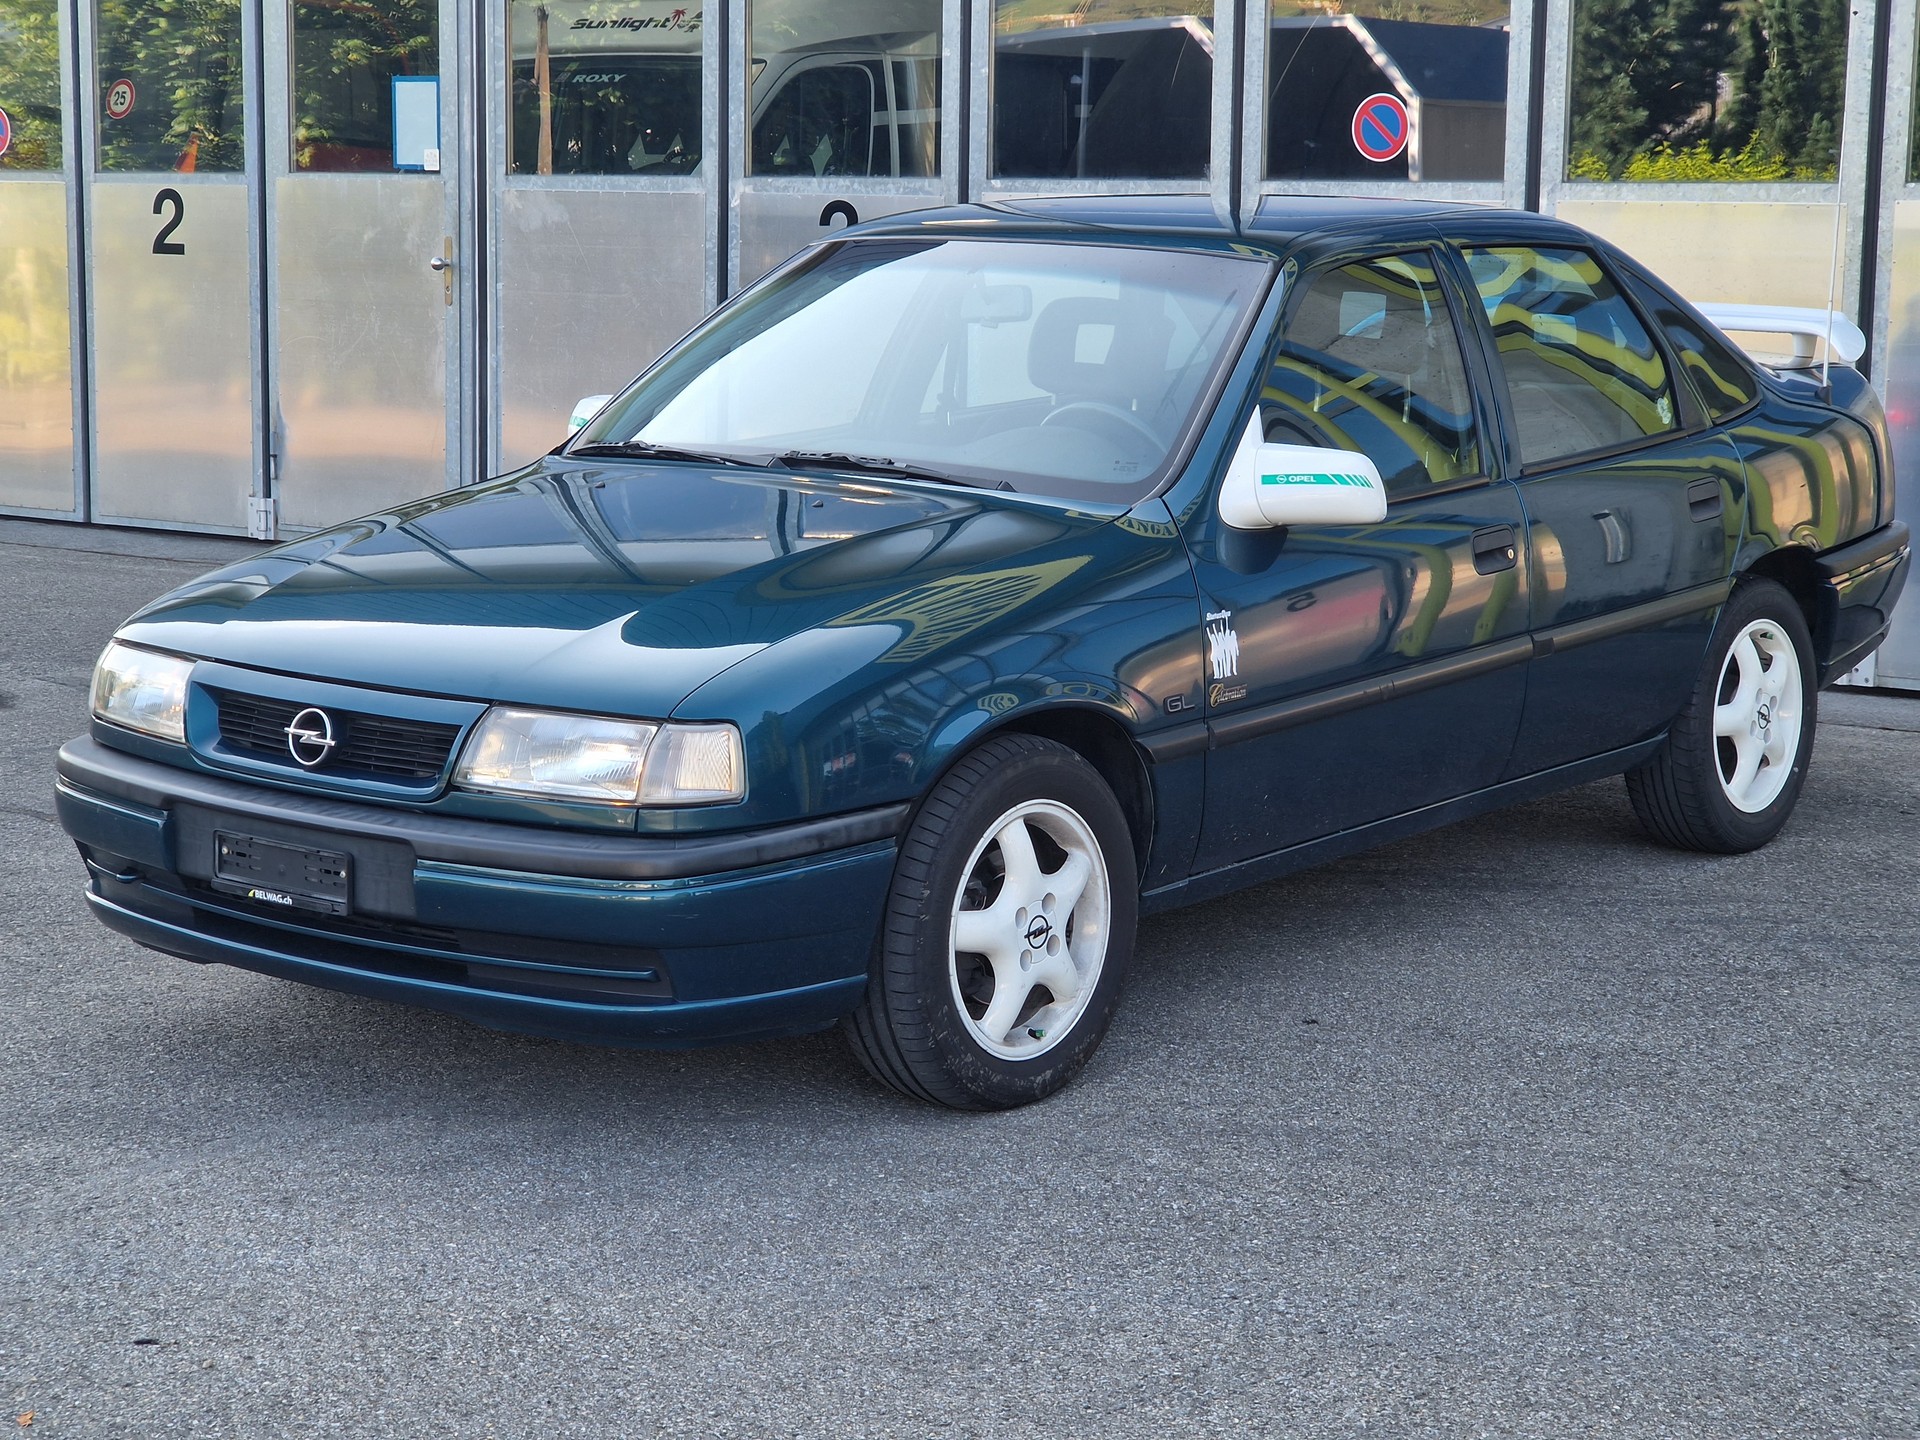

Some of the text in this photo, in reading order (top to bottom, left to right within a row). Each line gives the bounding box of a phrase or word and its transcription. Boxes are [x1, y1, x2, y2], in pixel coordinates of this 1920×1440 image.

[570, 17, 671, 32] Sunlight
[572, 74, 627, 83] ROXY
[113, 91, 127, 106] 25
[152, 188, 185, 256] 2
[1288, 475, 1317, 483] OPEL
[1167, 695, 1195, 712] GL
[254, 889, 293, 906] BELWAG.ch
